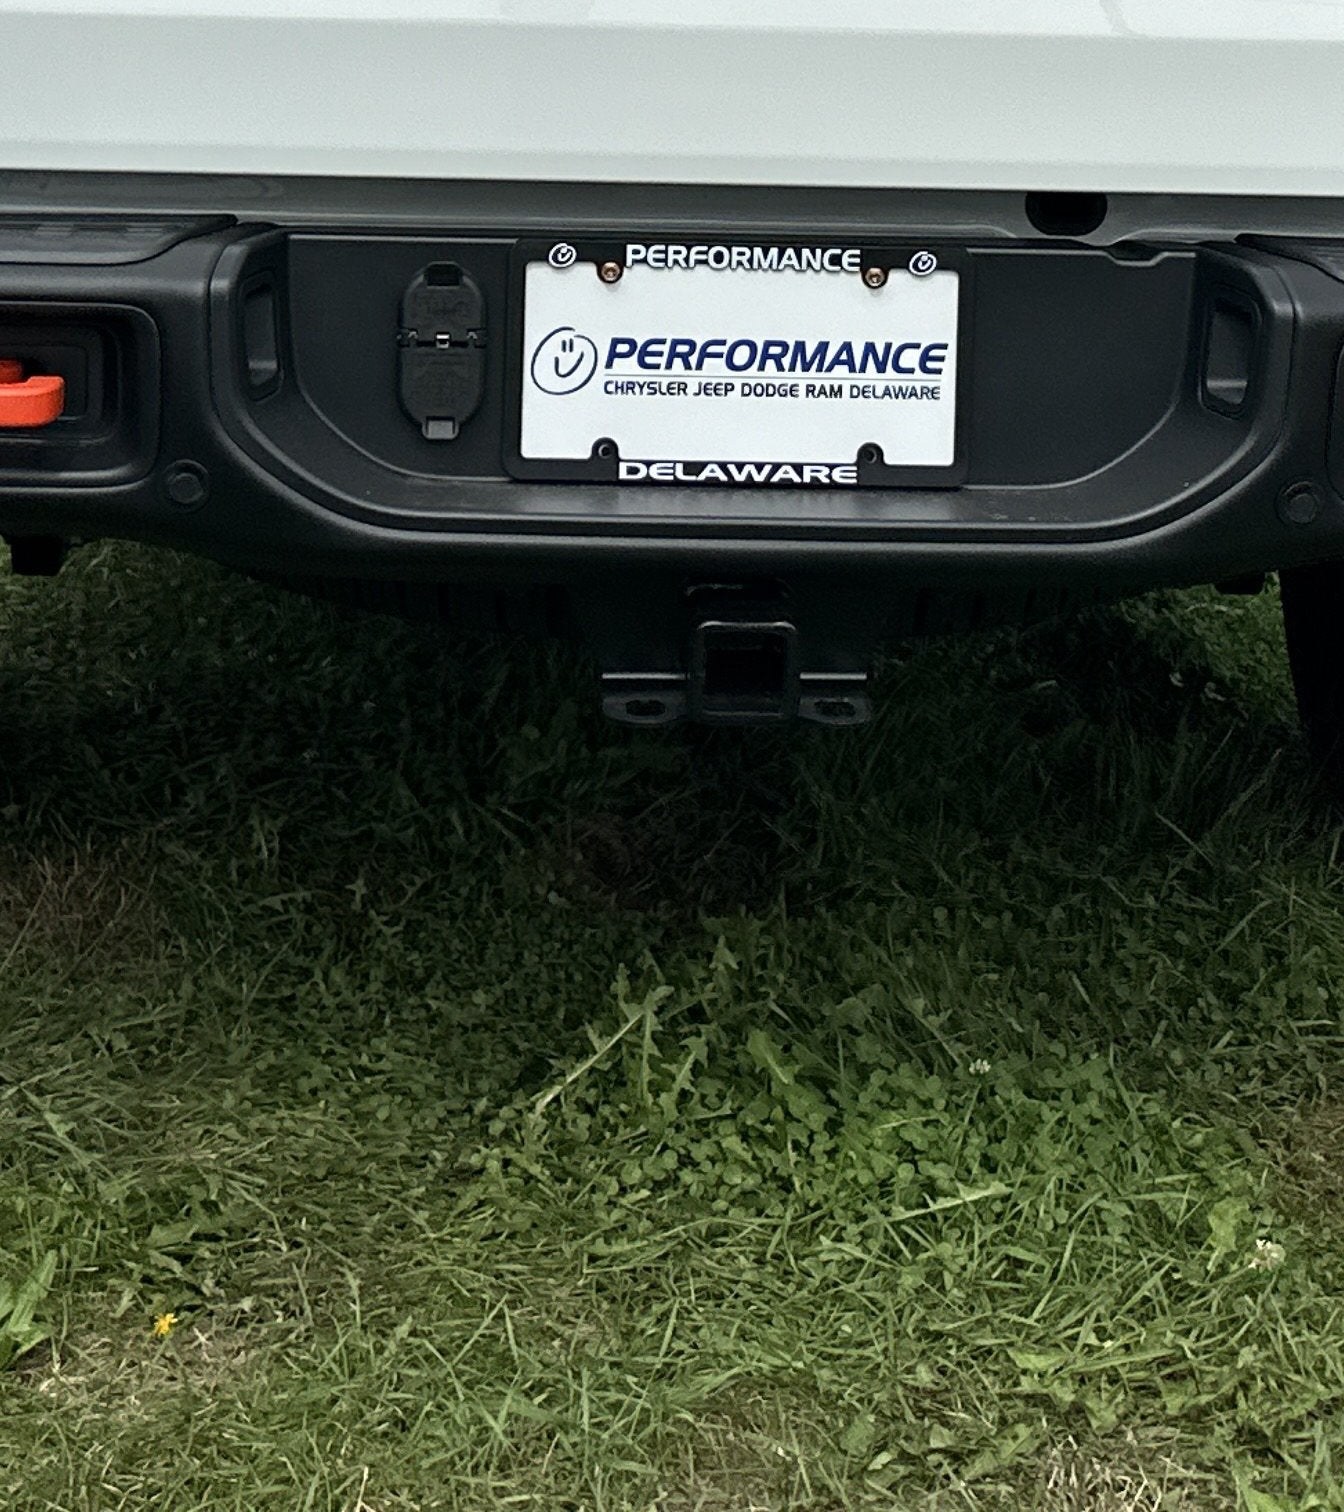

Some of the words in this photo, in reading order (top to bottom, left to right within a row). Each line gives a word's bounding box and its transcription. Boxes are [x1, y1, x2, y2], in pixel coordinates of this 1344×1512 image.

[625, 244, 861, 273] PERFORMANCE
[604, 337, 949, 375] PERFORMANCE
[603, 380, 688, 397] CHRYSLER
[692, 381, 735, 398] JEEP
[740, 382, 800, 399] DODGE
[805, 383, 843, 399] RAM
[849, 384, 942, 401] DELAWARE
[618, 462, 858, 484] DELAWARE
